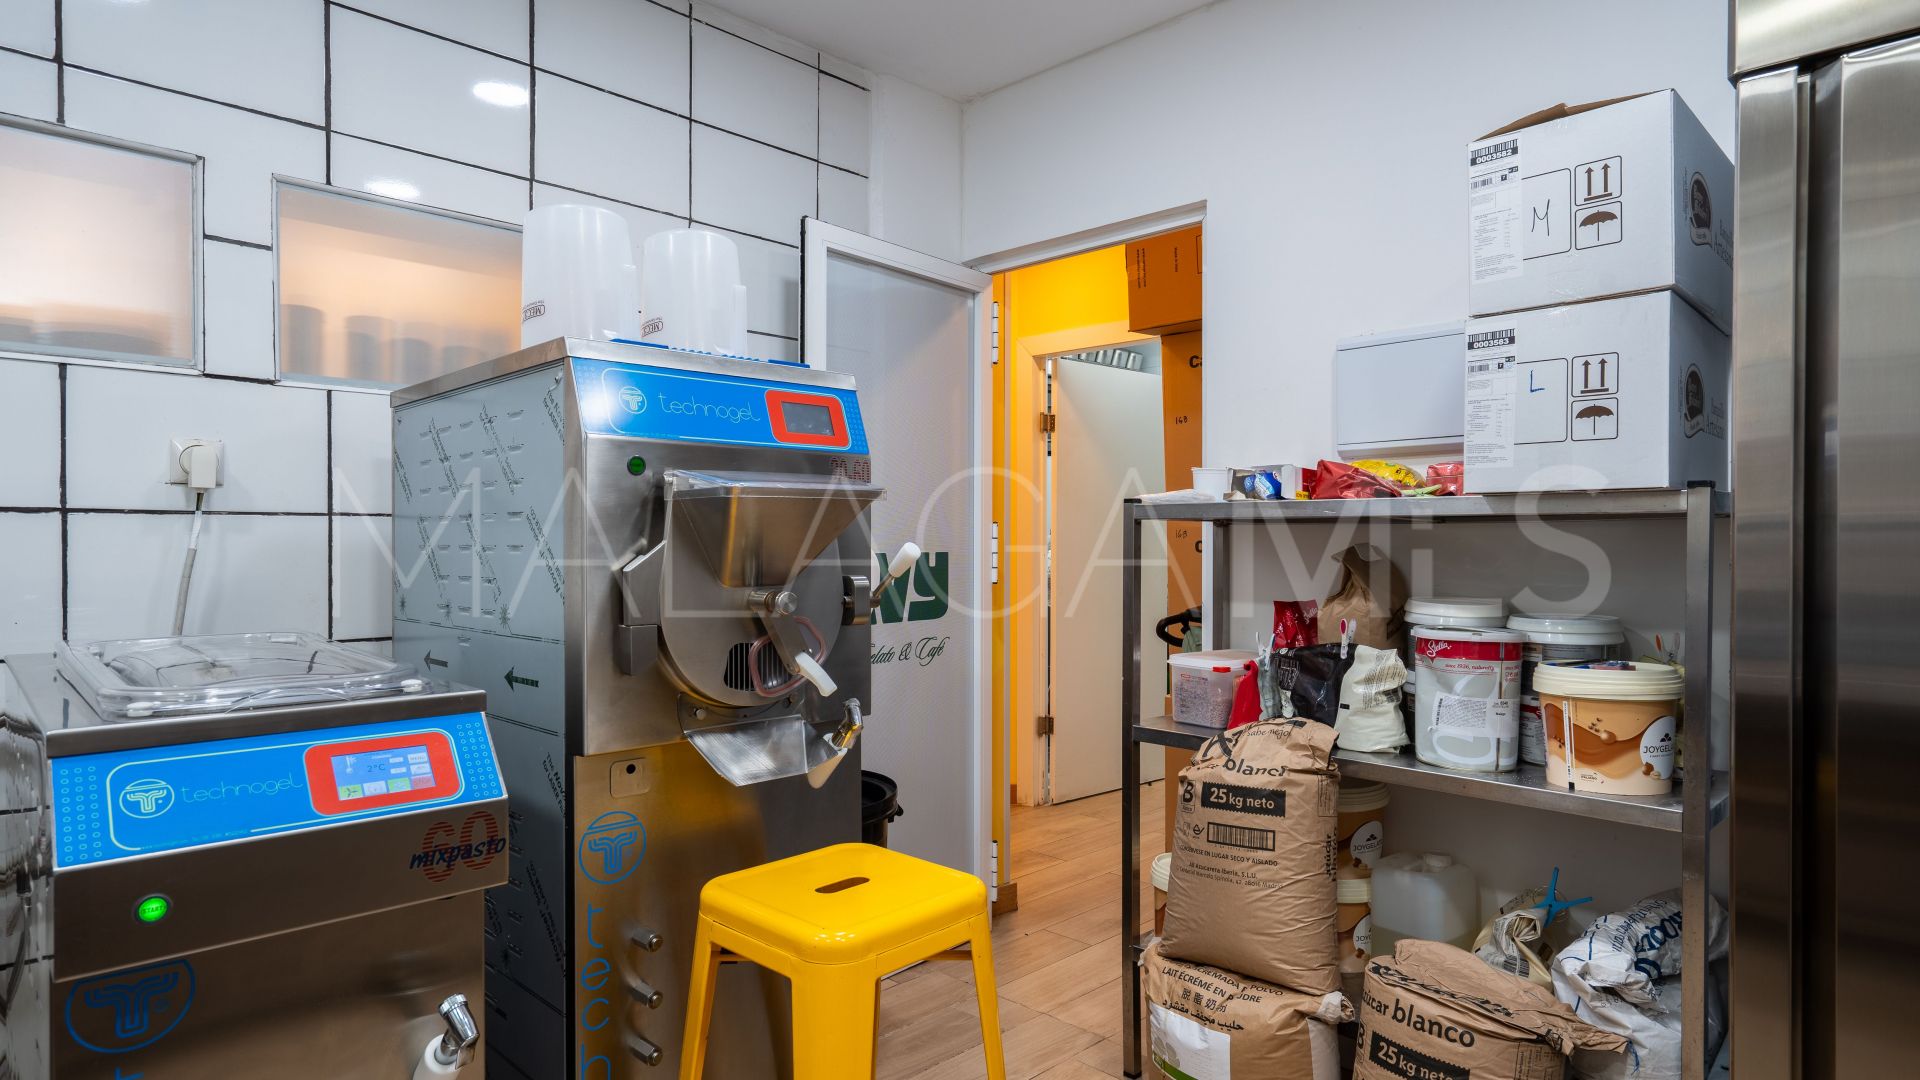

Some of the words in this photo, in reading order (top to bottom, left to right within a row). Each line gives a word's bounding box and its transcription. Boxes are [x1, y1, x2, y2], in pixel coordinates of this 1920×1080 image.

[1476, 150, 1513, 164] 0003582
[1531, 198, 1550, 237] M
[1473, 338, 1510, 349] 0003583
[1529, 369, 1545, 393] L
[658, 391, 760, 424] technogel
[871, 643, 896, 665] elato
[180, 771, 304, 804] technogel
[1209, 787, 1227, 803] 25
[1229, 793, 1243, 809] kg
[1246, 796, 1275, 810] neto
[408, 838, 507, 870] mixpasto
[1211, 852, 1229, 860] LUGAR
[1230, 854, 1245, 862] SECO
[1251, 858, 1278, 867] AISLADO
[1161, 966, 1177, 979] LAIT
[1179, 970, 1215, 992] ÉCRÉMÉ
[1213, 986, 1227, 998] EN
[1249, 984, 1284, 996] POLVO
[1391, 998, 1476, 1048] blanco
[1377, 1041, 1398, 1065] 25
[1399, 1053, 1417, 1077] kg
